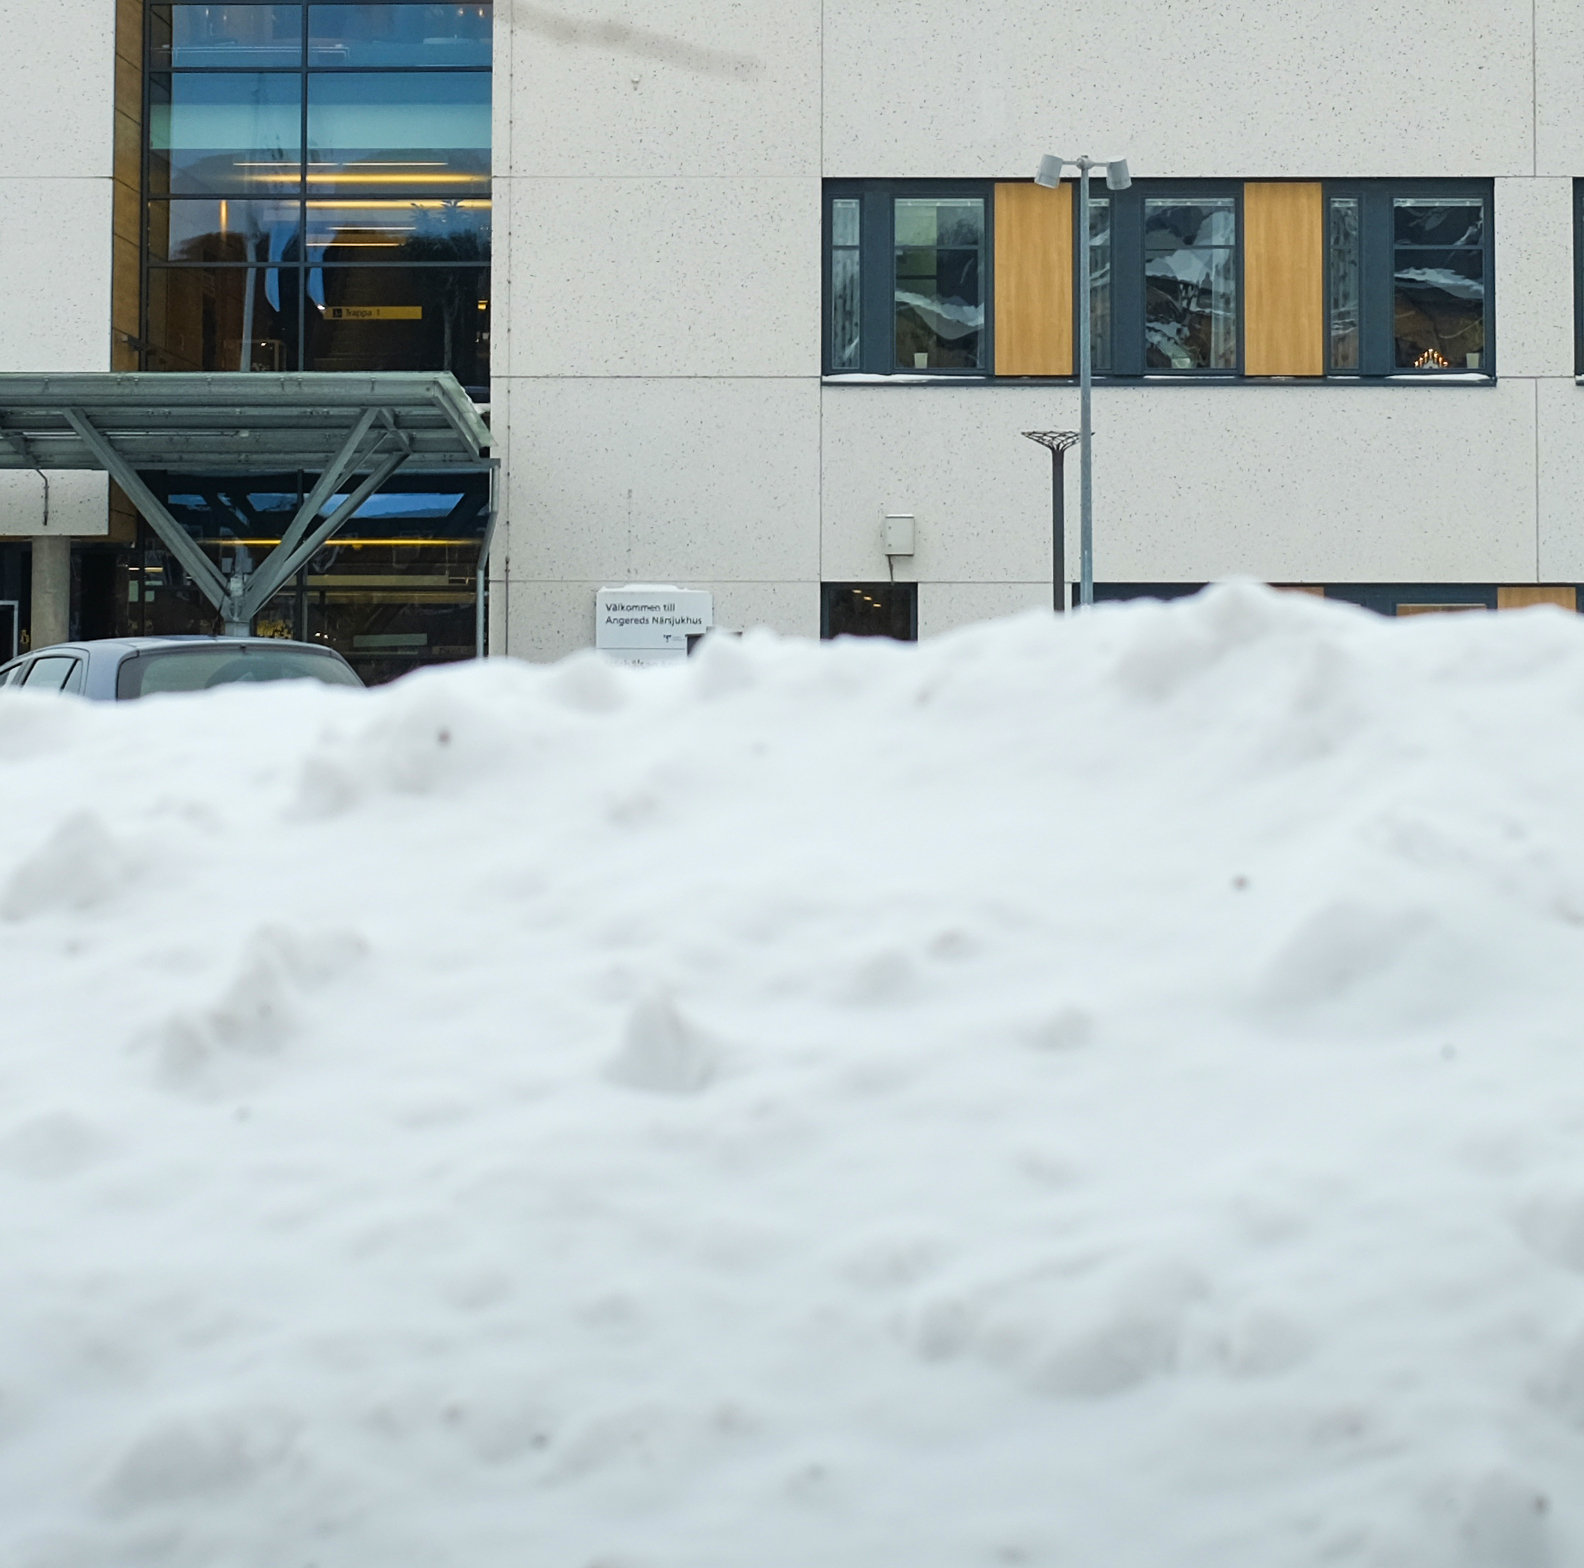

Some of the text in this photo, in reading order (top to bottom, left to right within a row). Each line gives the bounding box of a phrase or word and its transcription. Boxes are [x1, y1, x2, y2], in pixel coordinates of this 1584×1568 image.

[605, 603, 675, 612] Välkommen till
[605, 616, 702, 626] Angereds Närsjukhus
